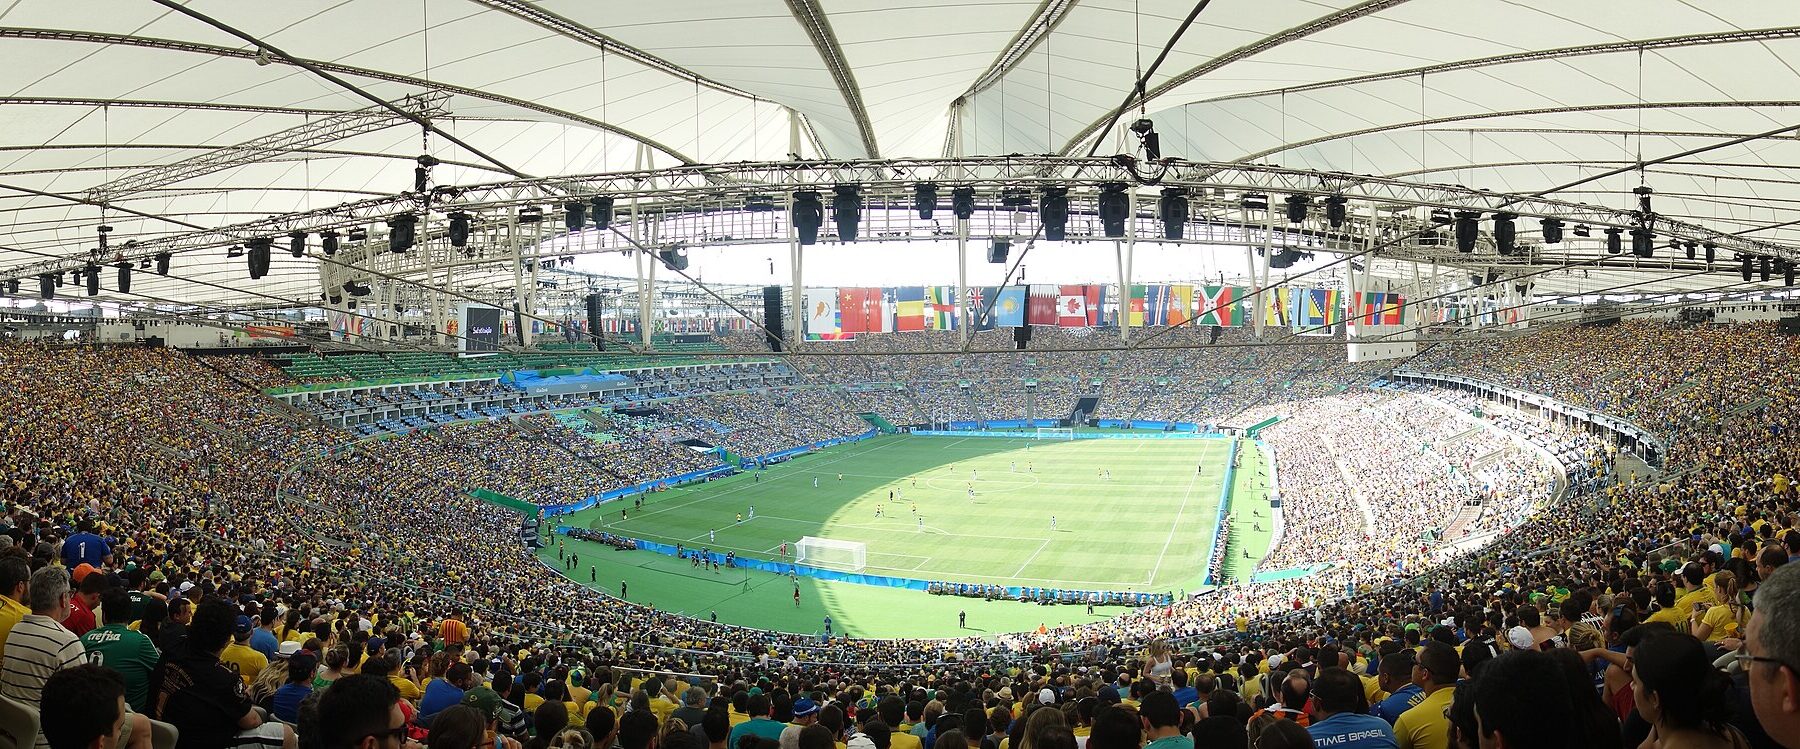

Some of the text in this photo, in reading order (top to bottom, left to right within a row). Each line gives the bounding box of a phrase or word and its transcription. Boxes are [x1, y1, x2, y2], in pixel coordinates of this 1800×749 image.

[79, 541, 86, 558] 1
[87, 630, 121, 643] crefisa
[1407, 690, 1427, 707] NEYM
[1314, 728, 1386, 747] TIME BRASIL
